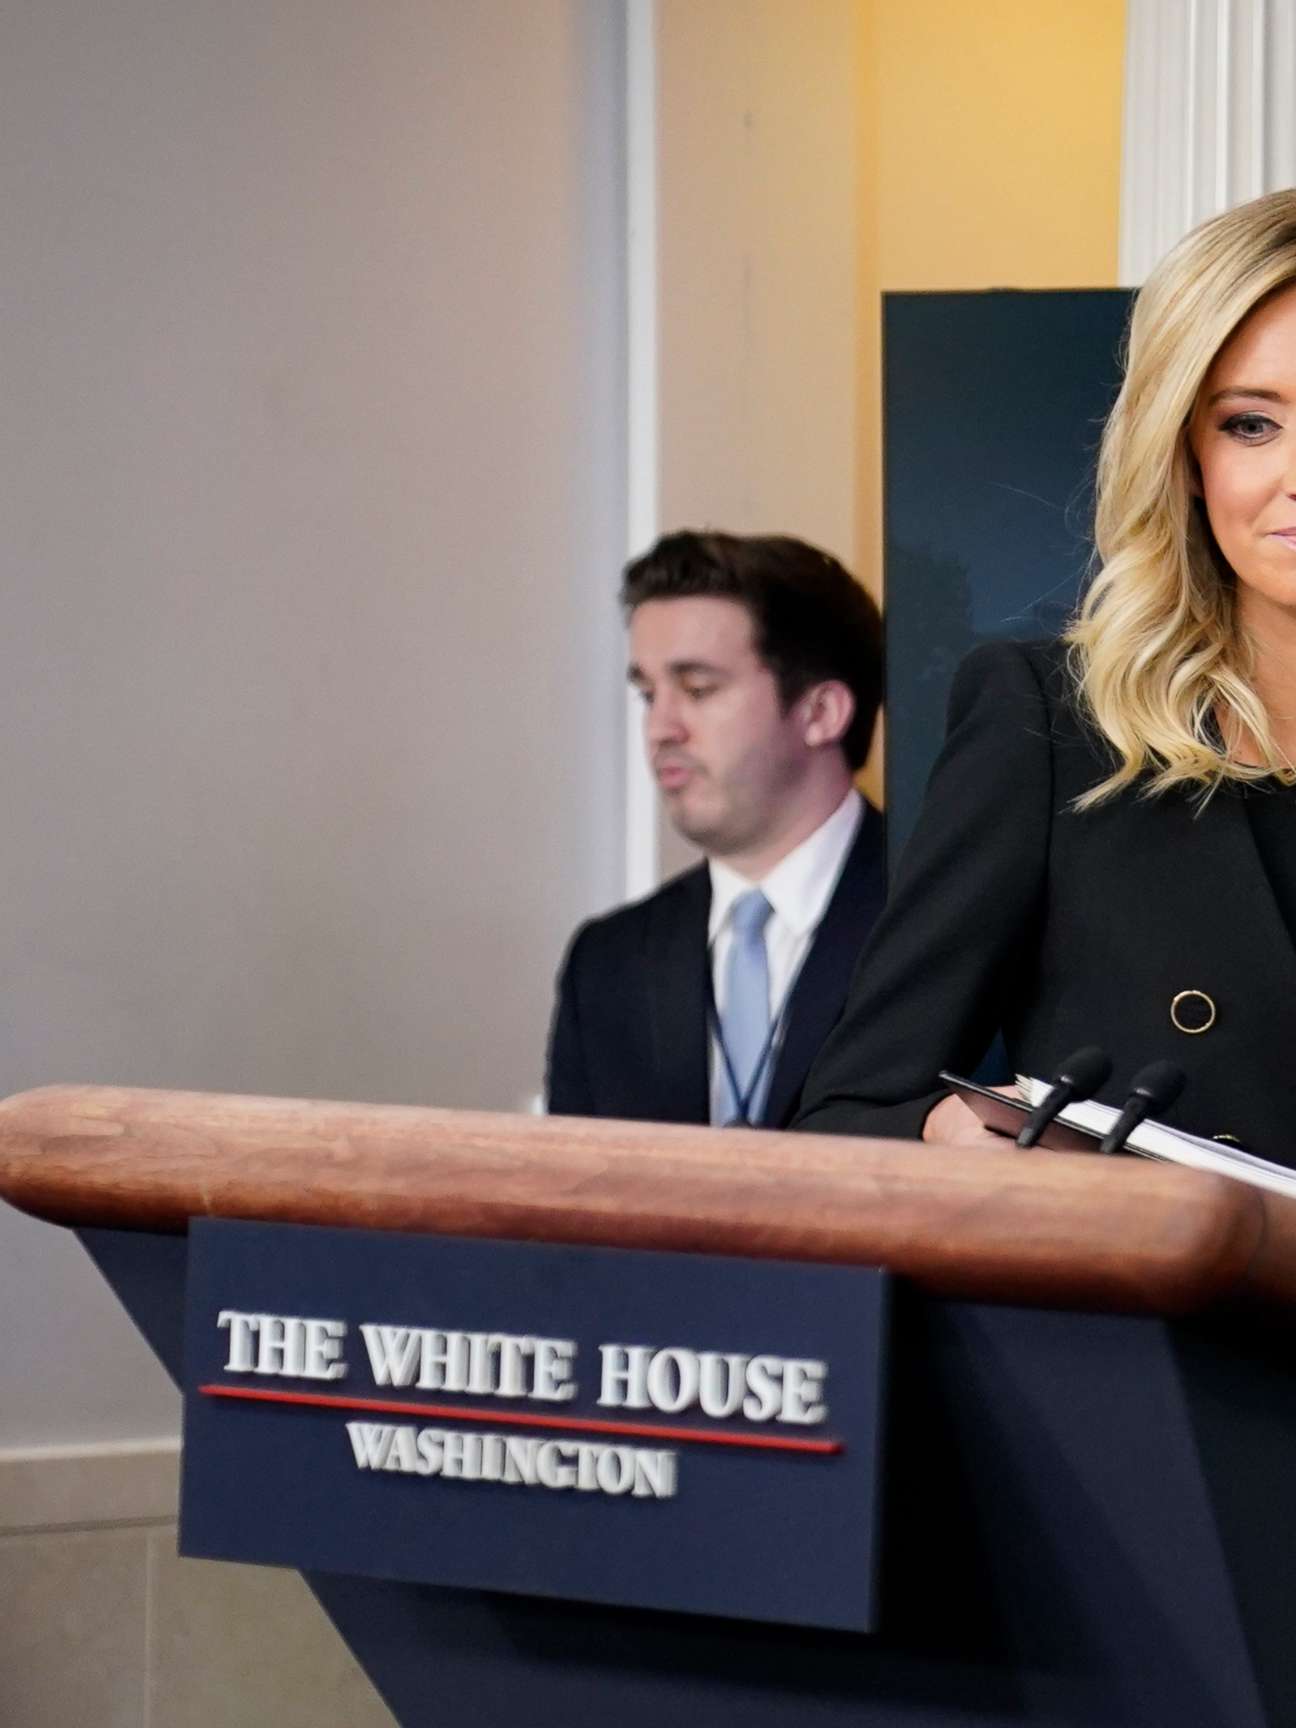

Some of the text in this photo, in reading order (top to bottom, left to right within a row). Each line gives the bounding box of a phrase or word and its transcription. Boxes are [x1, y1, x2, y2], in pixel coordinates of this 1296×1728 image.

[217, 1310, 828, 1425] THE WHITE HOUSE
[346, 1421, 678, 1499] WASHINGTON
